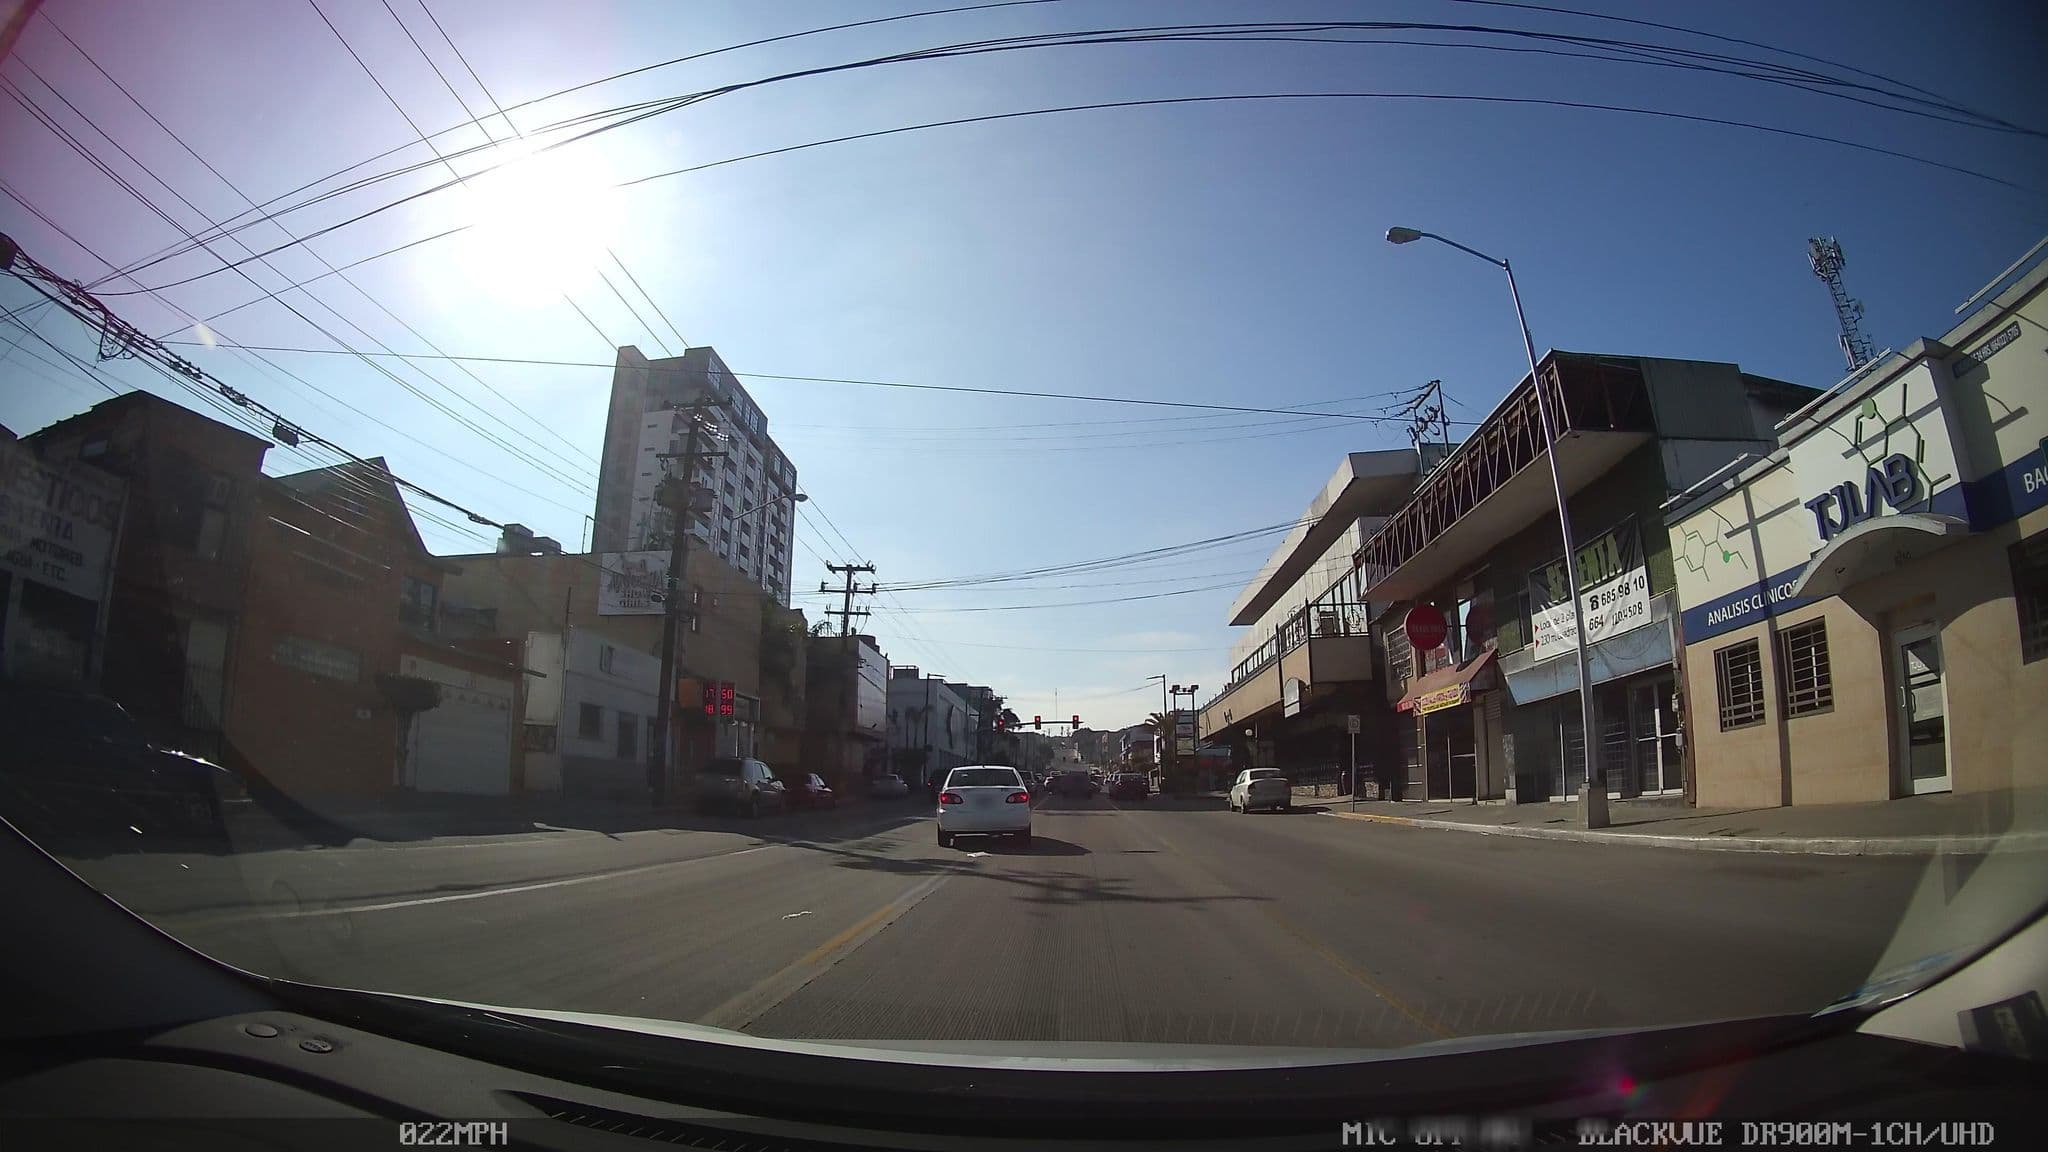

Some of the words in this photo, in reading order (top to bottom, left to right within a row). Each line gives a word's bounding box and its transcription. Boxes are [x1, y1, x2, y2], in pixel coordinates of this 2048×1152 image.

[1804, 453, 1916, 541] TJLAB
[1575, 532, 1623, 591] ENTA
[1589, 614, 1604, 631] 664
[1708, 598, 1750, 626] ANALISIS
[720, 704, 733, 715] 99
